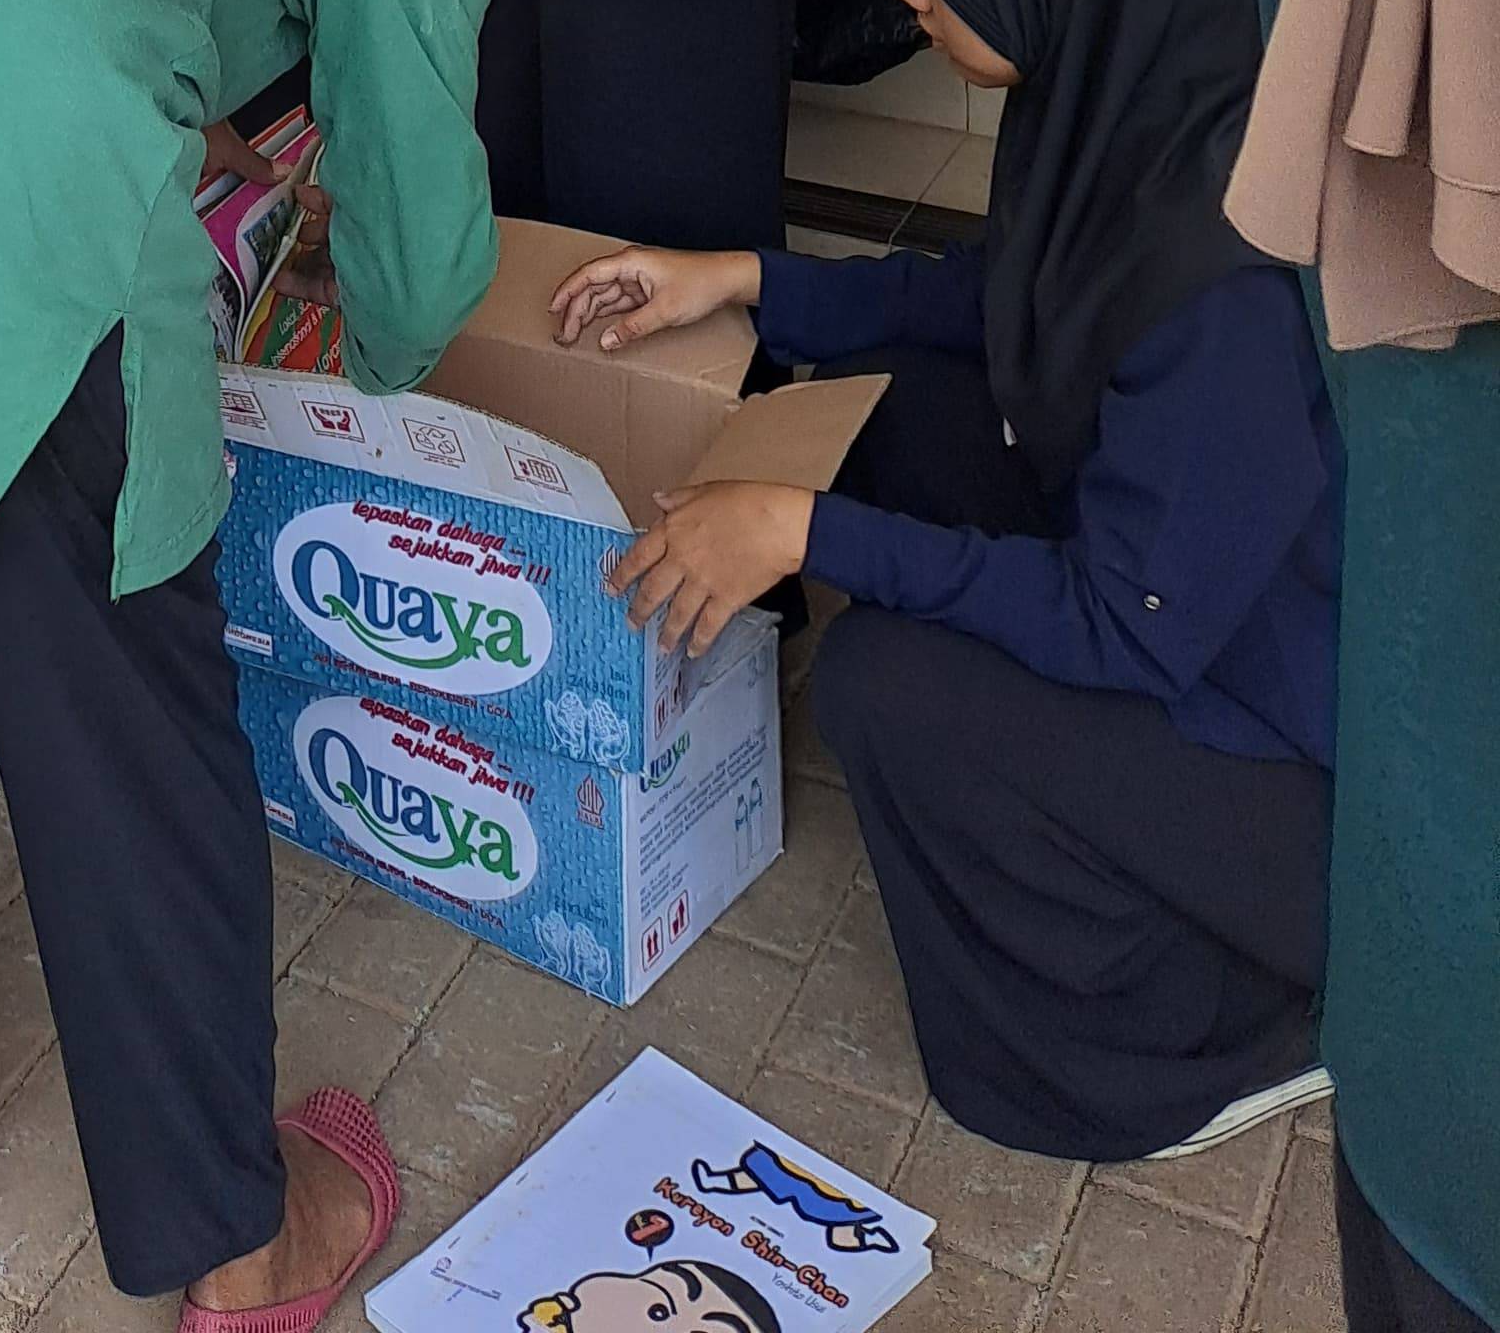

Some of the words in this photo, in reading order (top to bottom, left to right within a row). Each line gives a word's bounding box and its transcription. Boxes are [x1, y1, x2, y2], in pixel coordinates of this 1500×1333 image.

[352, 499, 433, 534] lepaskan
[437, 519, 506, 553] dahaga
[388, 534, 473, 567] sejukkan
[475, 552, 522, 581] jiwa
[291, 540, 532, 669] Quaya
[434, 725, 494, 765] dahaga
[308, 727, 520, 881] Quaya
[468, 764, 508, 794] jiwa
[653, 1177, 735, 1237] Kureyon
[741, 1229, 850, 1309] Shin-Chan
